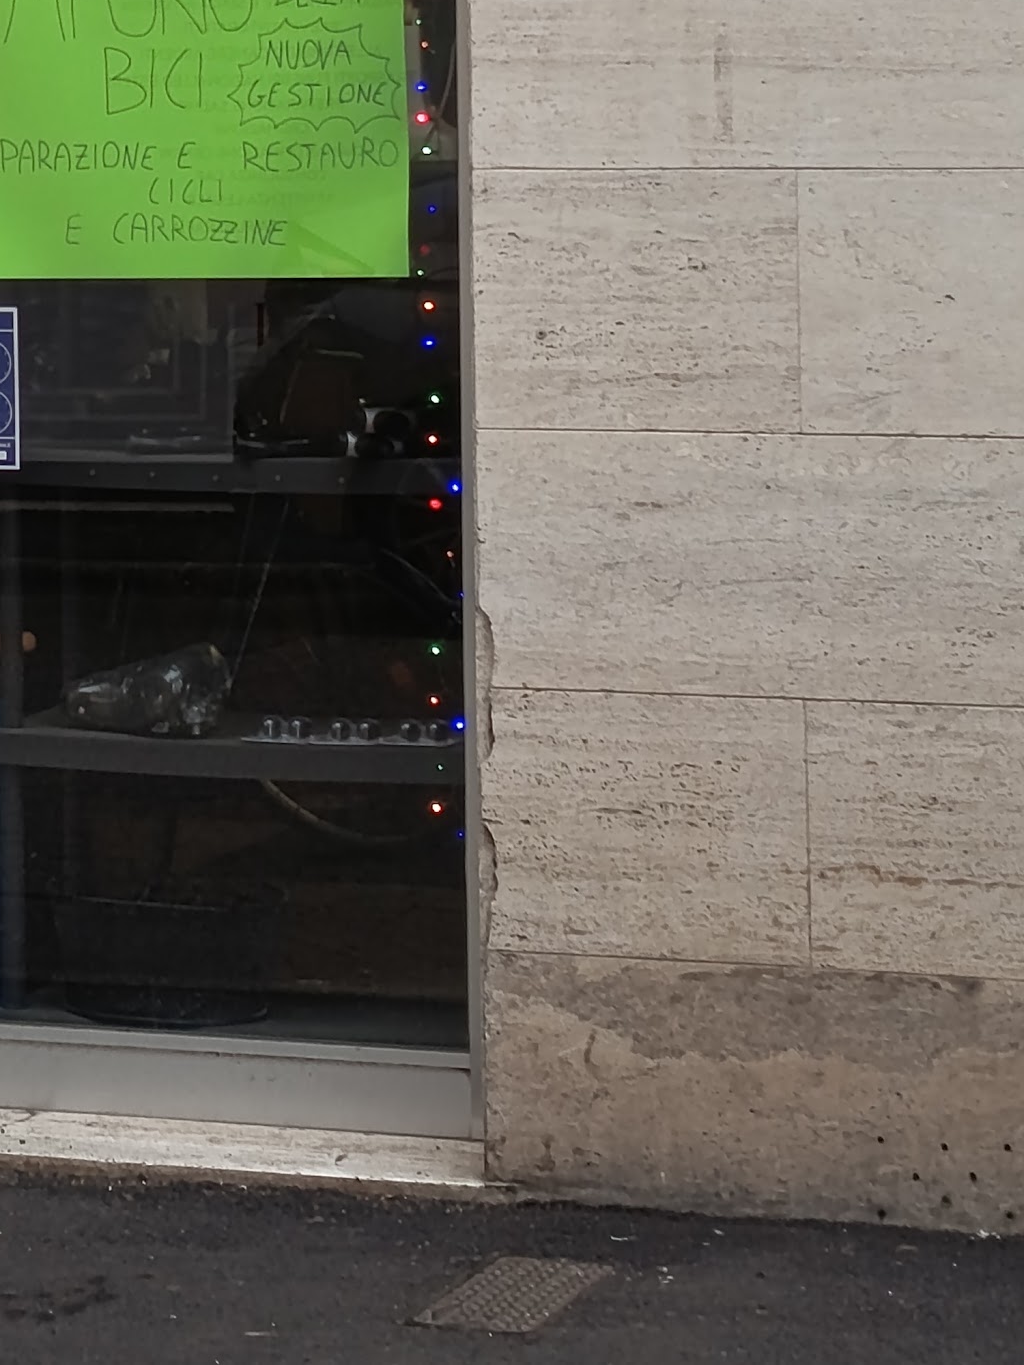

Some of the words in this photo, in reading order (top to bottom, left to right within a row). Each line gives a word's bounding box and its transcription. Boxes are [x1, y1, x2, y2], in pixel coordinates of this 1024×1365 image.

[266, 40, 352, 70] NUOVA
[104, 46, 203, 115] BICI
[247, 80, 386, 109] GESTIONE
[177, 141, 197, 170] E
[243, 137, 399, 172] RESTAURO
[148, 178, 223, 205] CICLI
[65, 214, 81, 245] E
[112, 213, 288, 246] CARROZZINE
